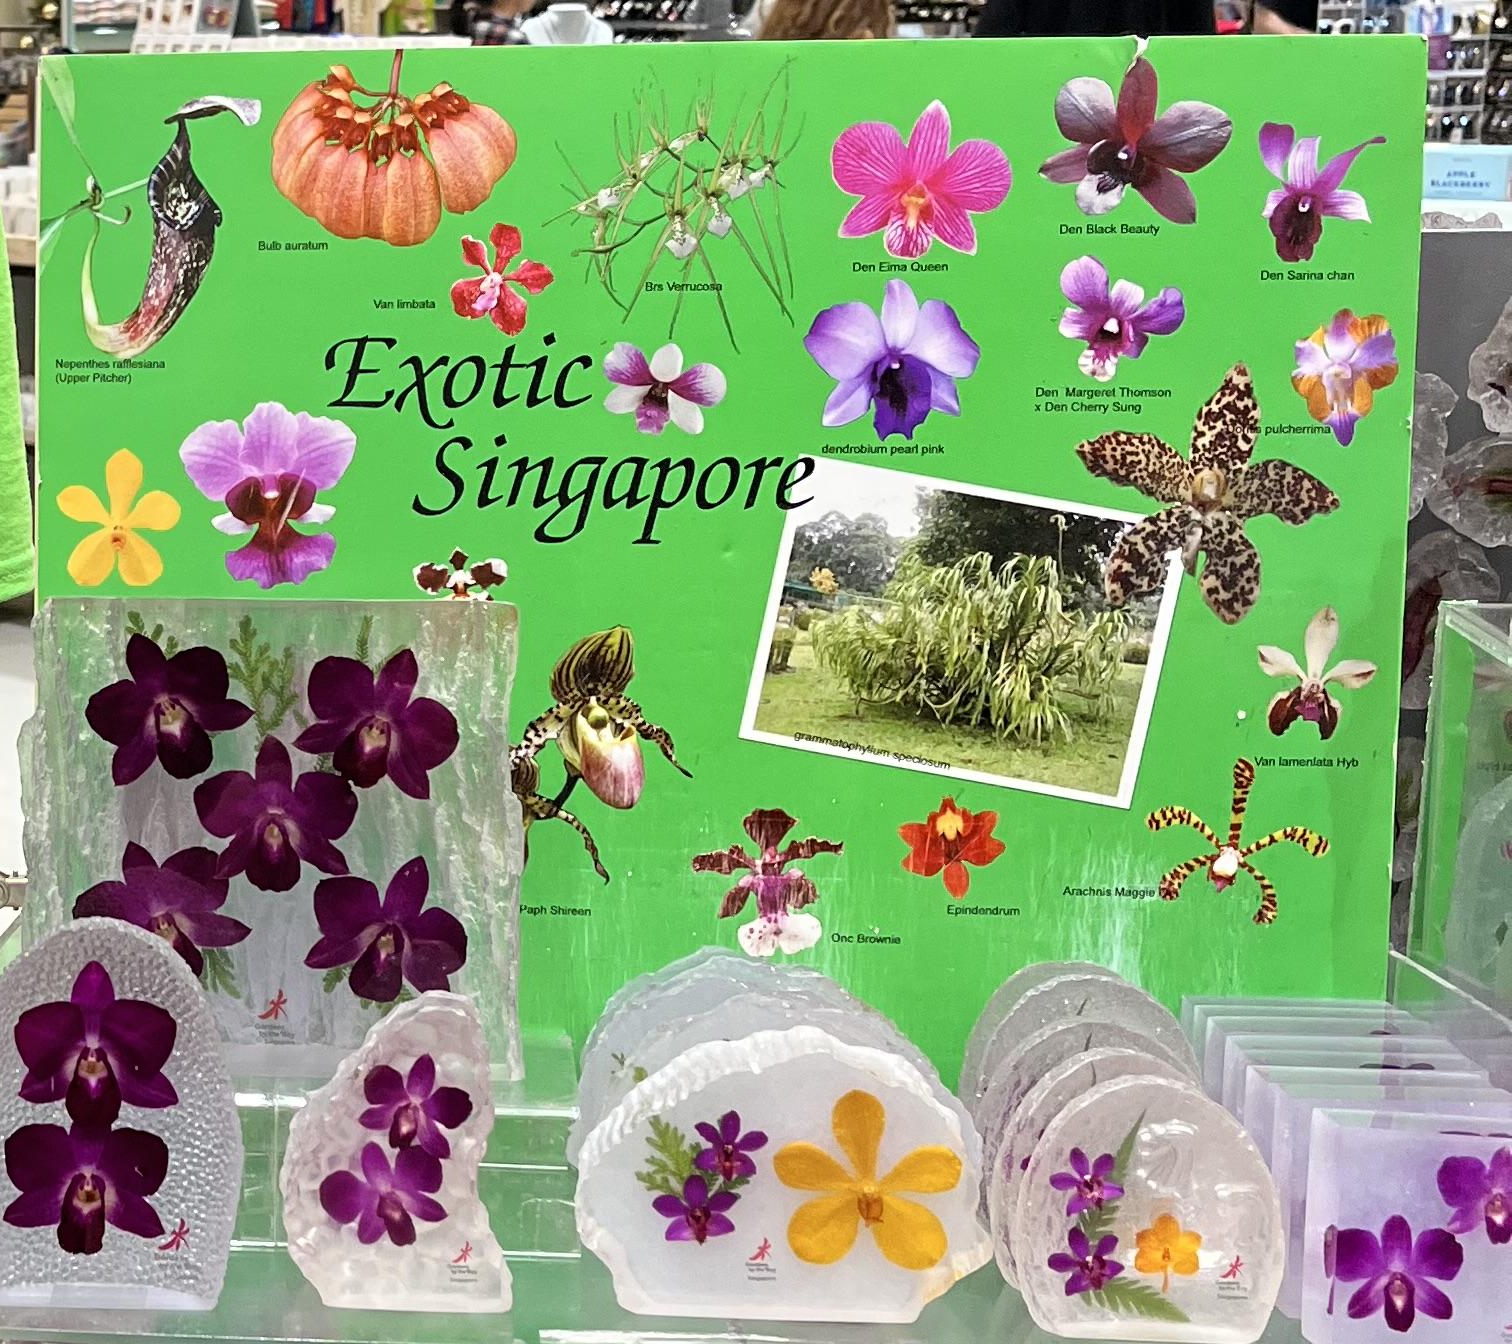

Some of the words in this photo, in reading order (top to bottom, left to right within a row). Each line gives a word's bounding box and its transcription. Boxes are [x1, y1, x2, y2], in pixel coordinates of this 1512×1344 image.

[1059, 223, 1083, 234] Den
[1086, 223, 1117, 234] Black
[1120, 223, 1161, 237] Beauty
[852, 261, 876, 272] Den
[910, 261, 949, 273] Queen
[1260, 269, 1284, 281] Den
[1287, 269, 1324, 281] Sarina
[1327, 270, 1356, 281] chan
[645, 281, 664, 292] Brs
[667, 280, 723, 292] Verrucosa
[373, 299, 394, 309] Van
[397, 299, 436, 309] limbata
[55, 359, 110, 370] Nepenthes
[55, 372, 90, 384] (Upper
[92, 372, 132, 384] Pitcher)
[324, 332, 593, 430] Exotic
[1035, 387, 1059, 397] Den
[1119, 387, 1172, 398] Thomson
[1034, 403, 1041, 412] x
[1044, 401, 1068, 412] Den
[1070, 401, 1109, 414] Cherry
[1112, 401, 1142, 414] Sung
[1265, 423, 1332, 437] pulcherrima
[821, 443, 888, 454] dendrobium
[890, 443, 919, 457] pearl
[921, 443, 945, 457] pink
[412, 433, 816, 545] Singapore
[1254, 756, 1276, 767] Van
[1336, 757, 1359, 769] Hyb
[1062, 886, 1112, 896] Arachnis
[1114, 887, 1156, 899] Maggie
[520, 904, 547, 916] Paph
[550, 905, 591, 916] Shireen
[947, 904, 1021, 916] Epindendrum
[831, 932, 854, 943] Onc
[857, 933, 901, 944] Brownie
